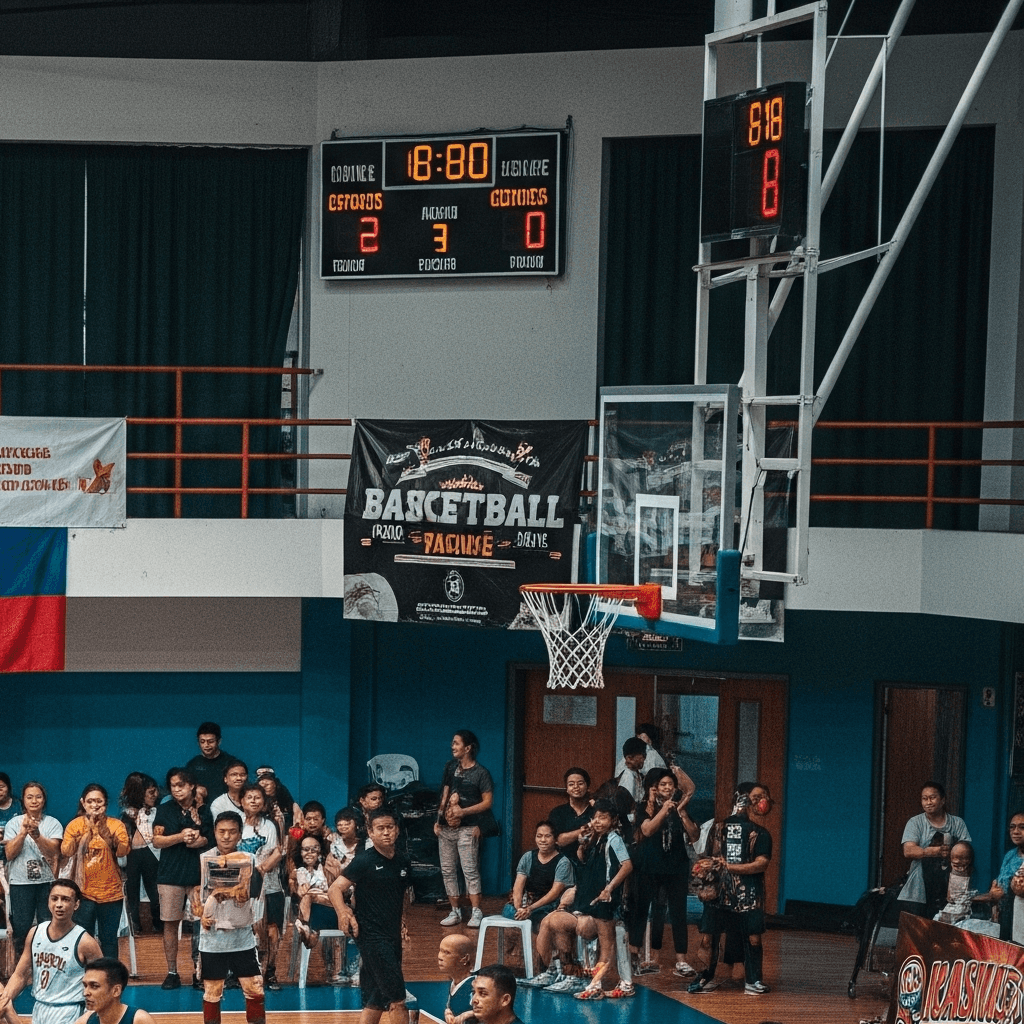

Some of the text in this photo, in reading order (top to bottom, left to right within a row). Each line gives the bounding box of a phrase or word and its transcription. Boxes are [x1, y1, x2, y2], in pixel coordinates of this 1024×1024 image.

[360, 216, 379, 253] 2
[432, 223, 447, 253] 3
[525, 211, 545, 248] 0
